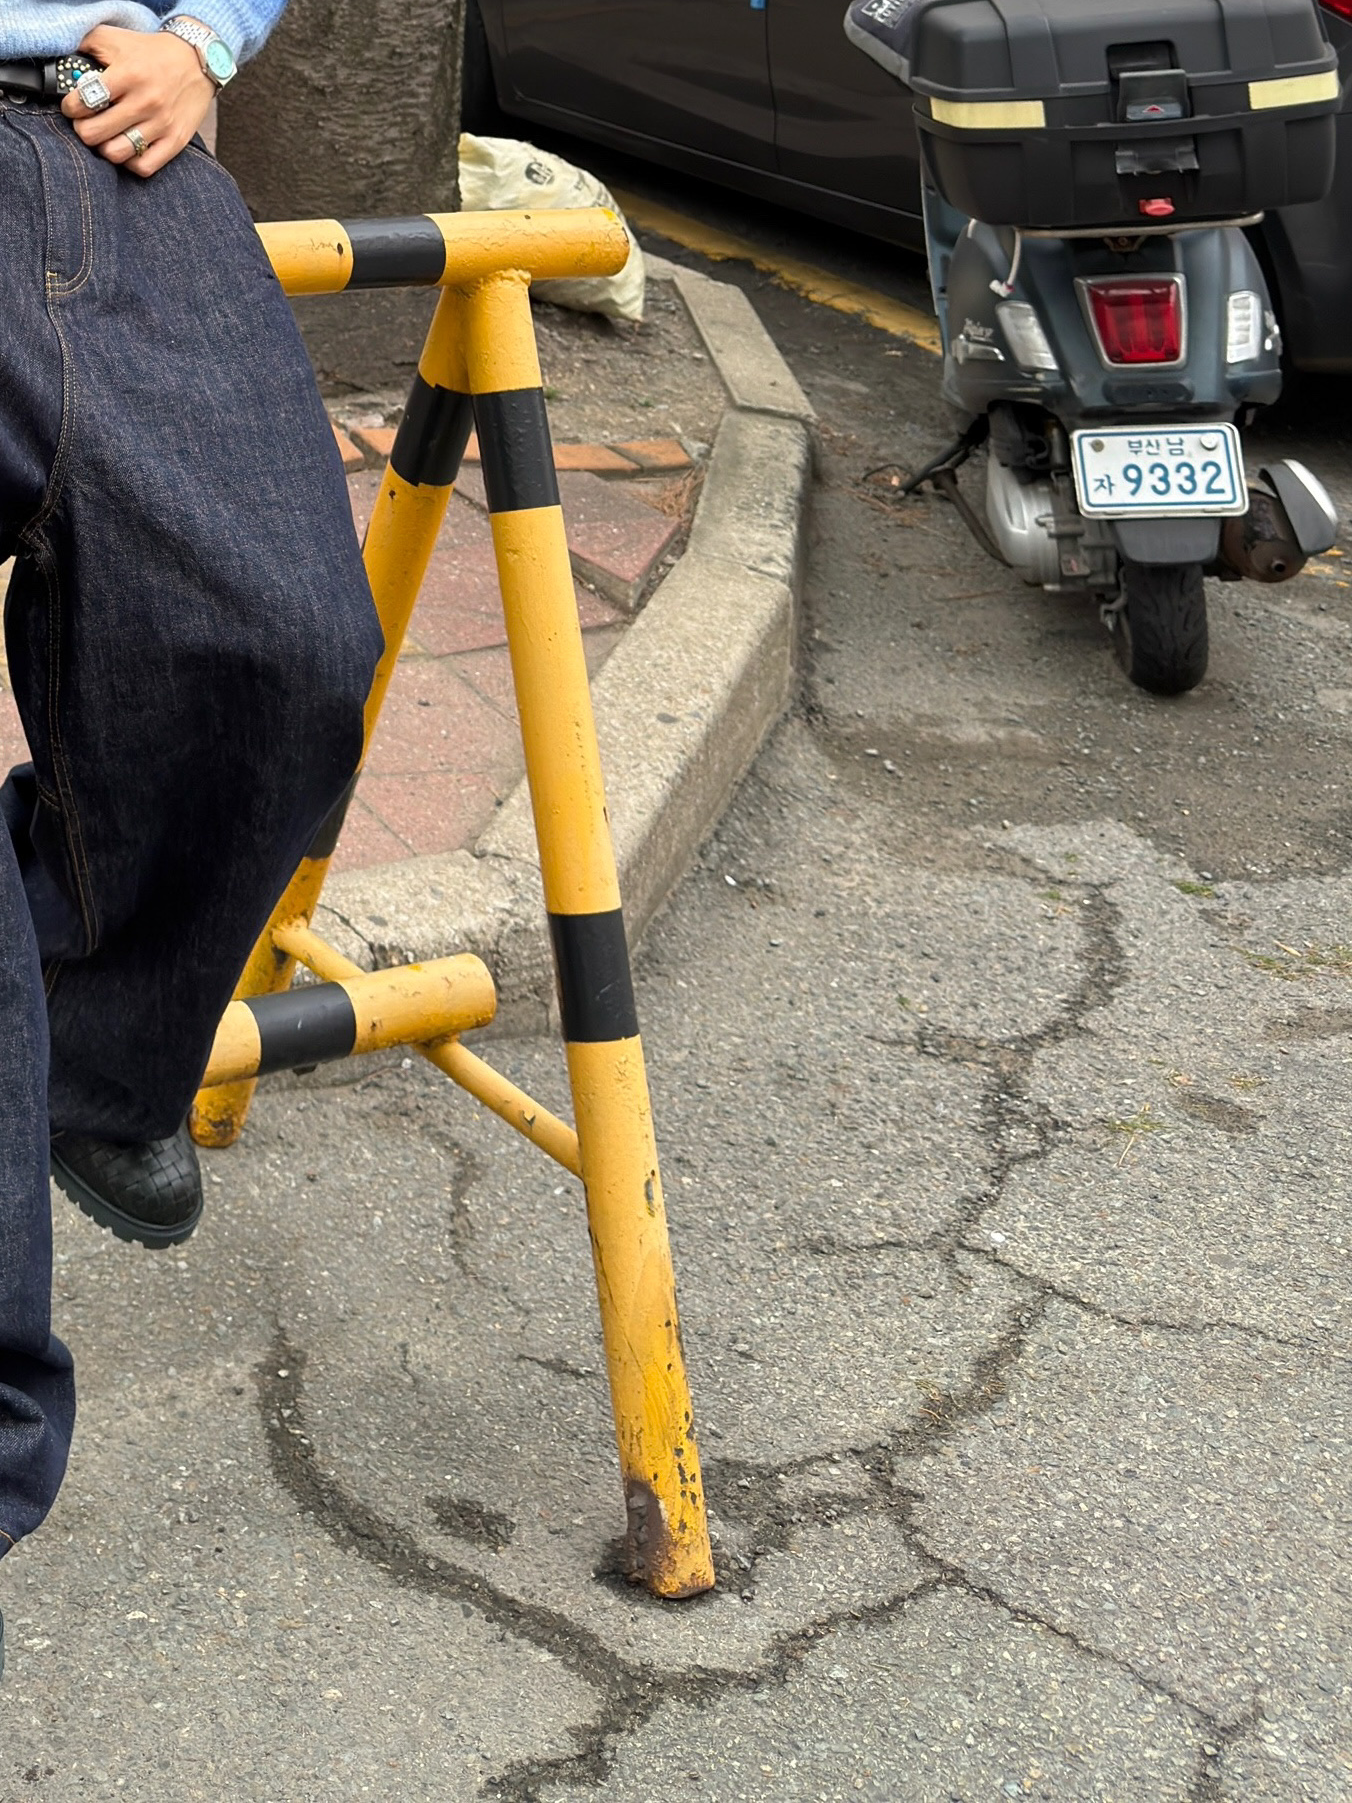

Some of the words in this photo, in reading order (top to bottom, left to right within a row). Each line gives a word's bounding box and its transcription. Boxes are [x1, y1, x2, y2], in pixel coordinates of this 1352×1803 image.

[1127, 439, 1161, 456] 부산
[1166, 437, 1185, 456] 남
[1093, 473, 1115, 496] 자
[1122, 460, 1226, 496] 9332
